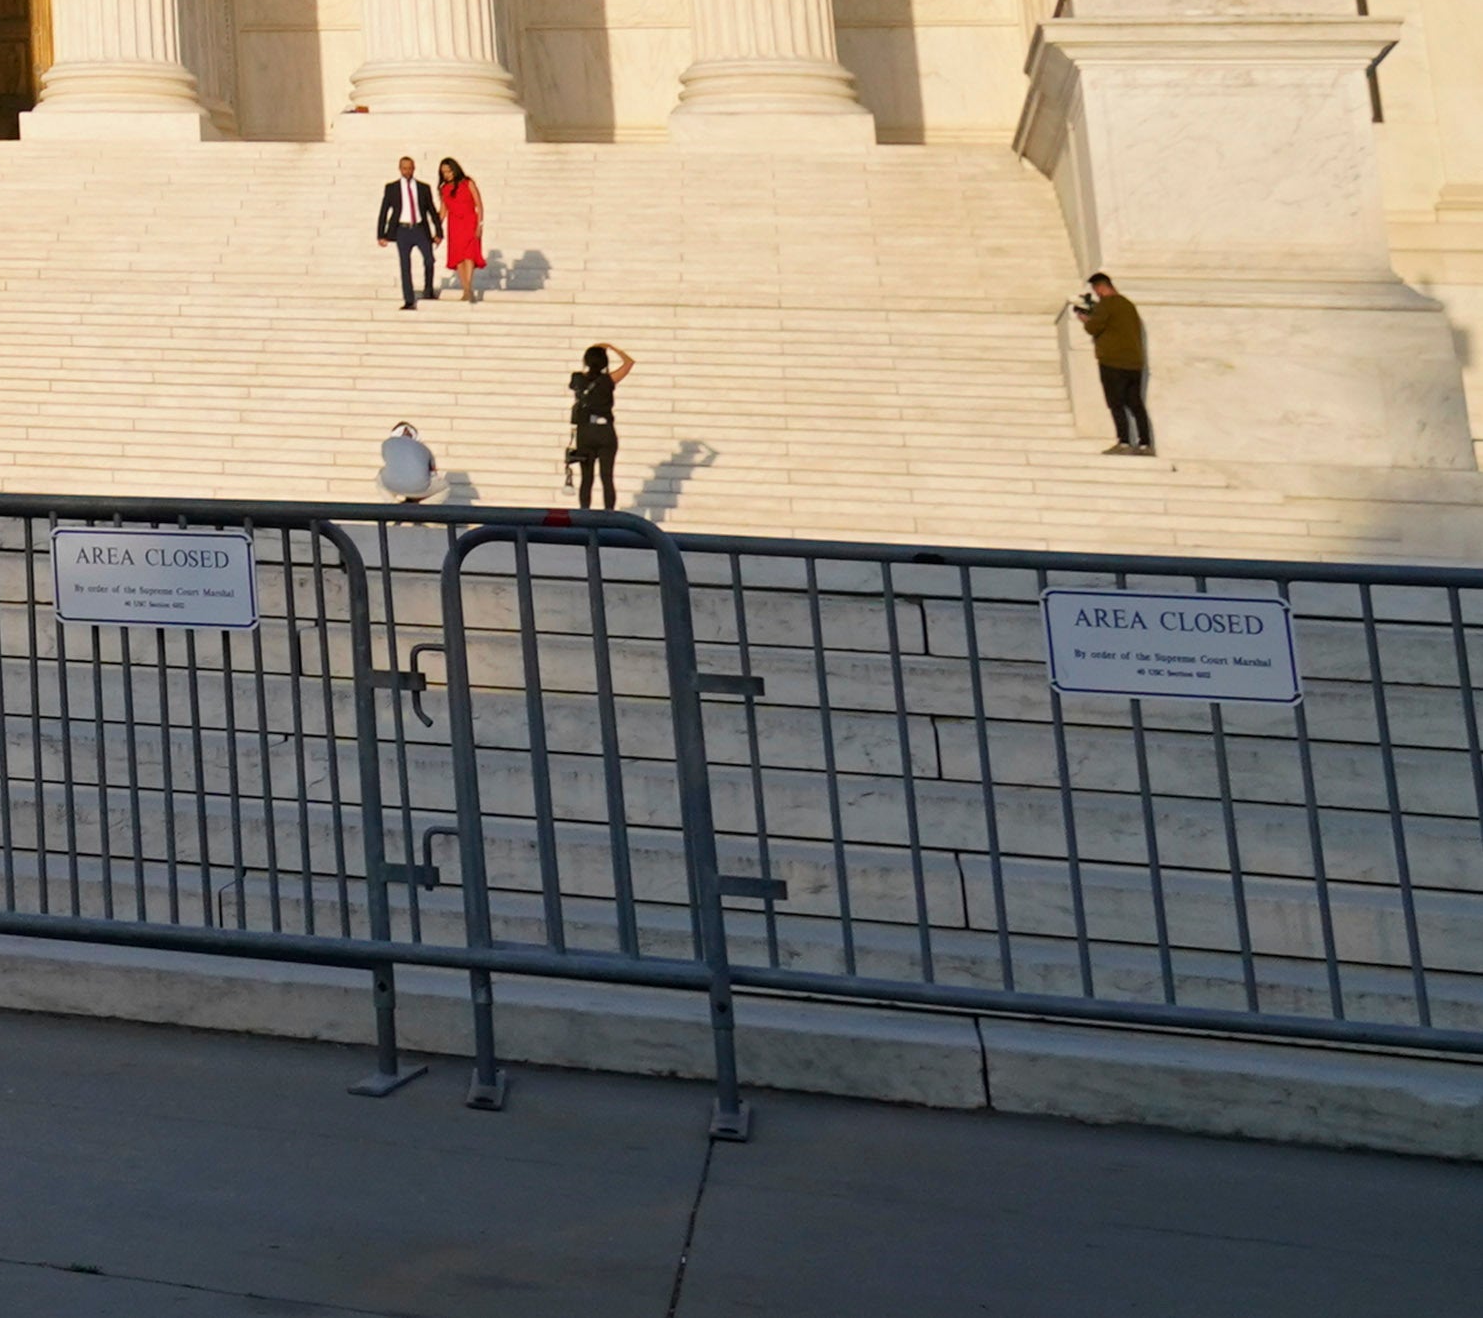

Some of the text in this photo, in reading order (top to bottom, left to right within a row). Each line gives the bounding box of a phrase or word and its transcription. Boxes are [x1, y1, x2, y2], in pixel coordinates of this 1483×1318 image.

[75, 546, 230, 569] AREA CLOSED
[1074, 608, 1264, 636] AREA CLOSED
